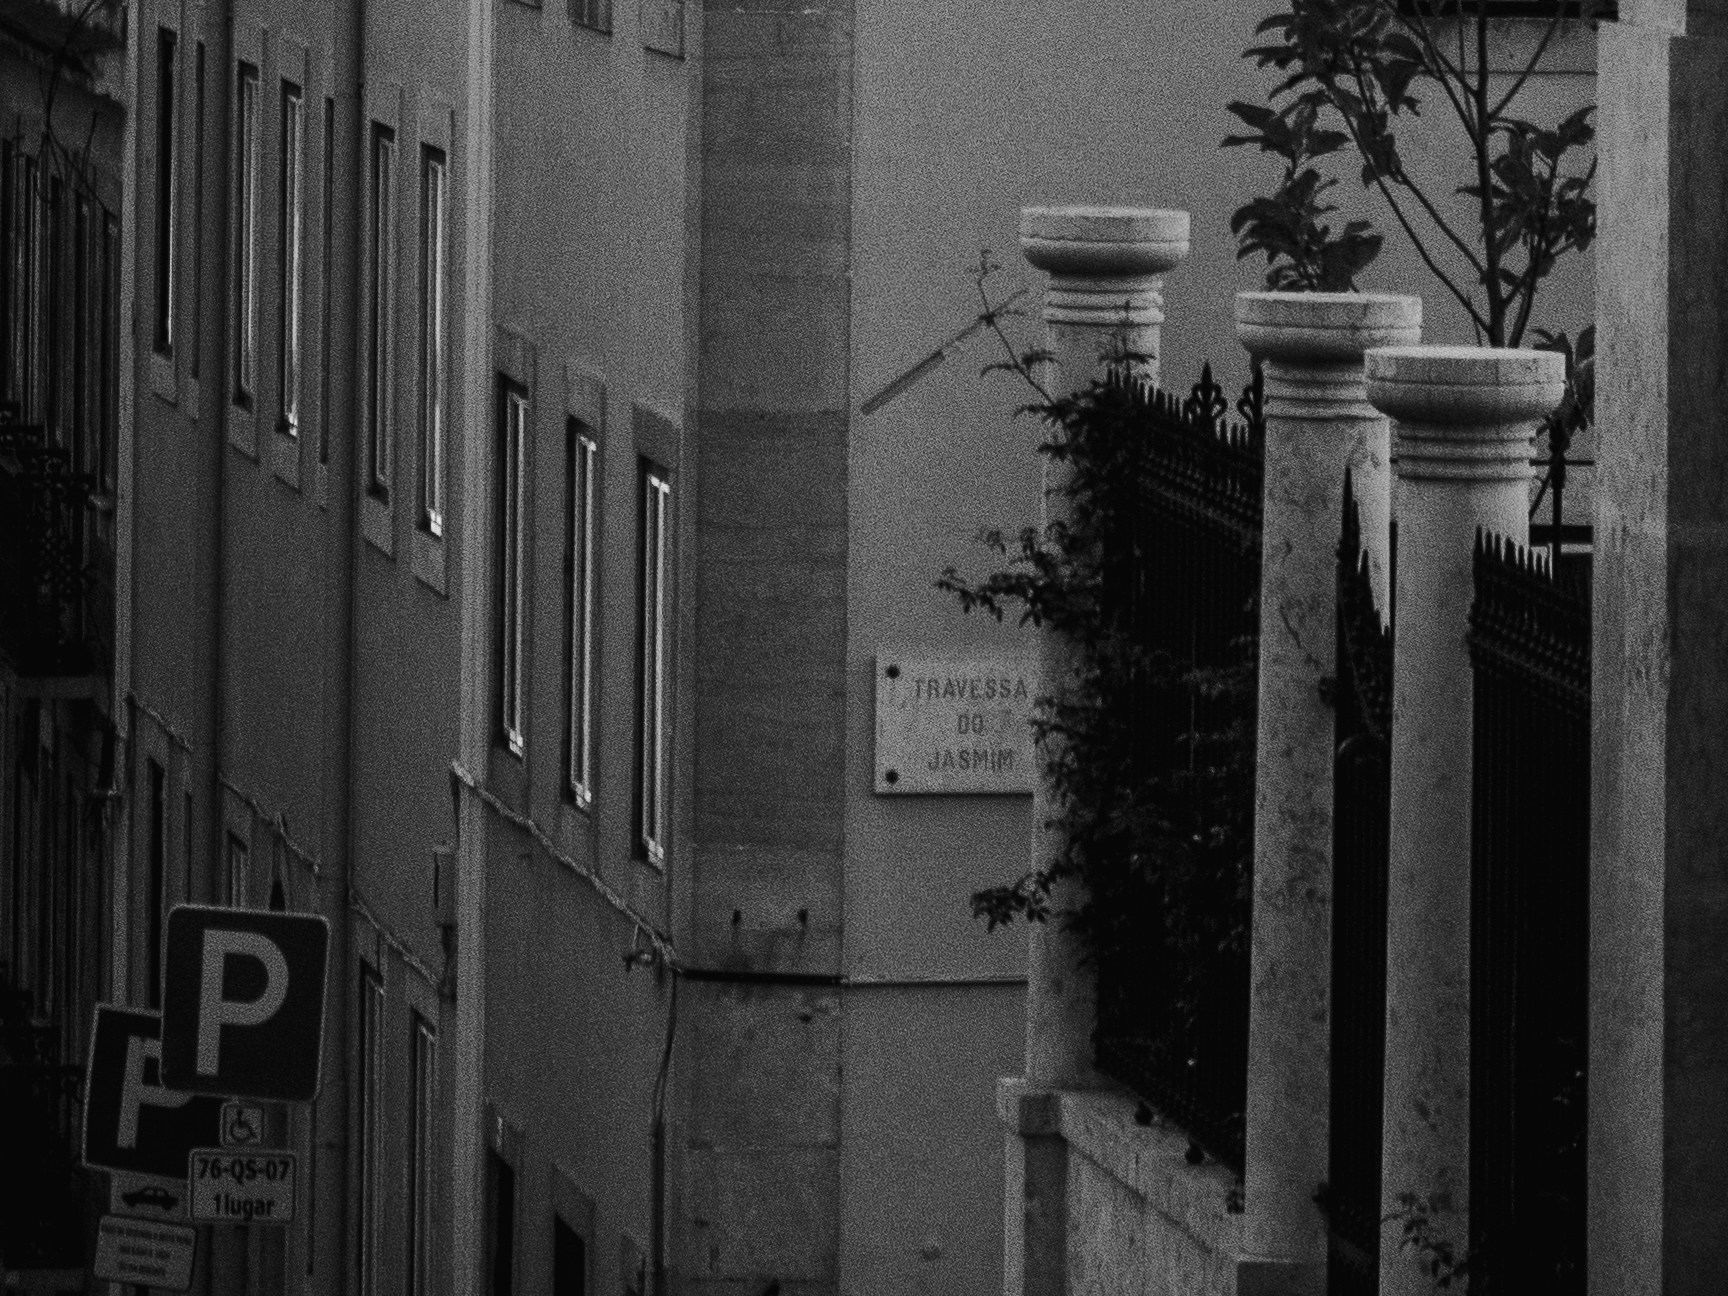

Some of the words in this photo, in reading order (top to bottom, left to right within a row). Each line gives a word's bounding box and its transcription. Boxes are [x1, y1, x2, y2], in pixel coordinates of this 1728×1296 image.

[914, 678, 1027, 700] TRAVESSA
[957, 713, 984, 735] DO
[927, 749, 1014, 771] JASMIM
[196, 928, 289, 1076] P
[198, 1158, 290, 1186] 76-QS-07
